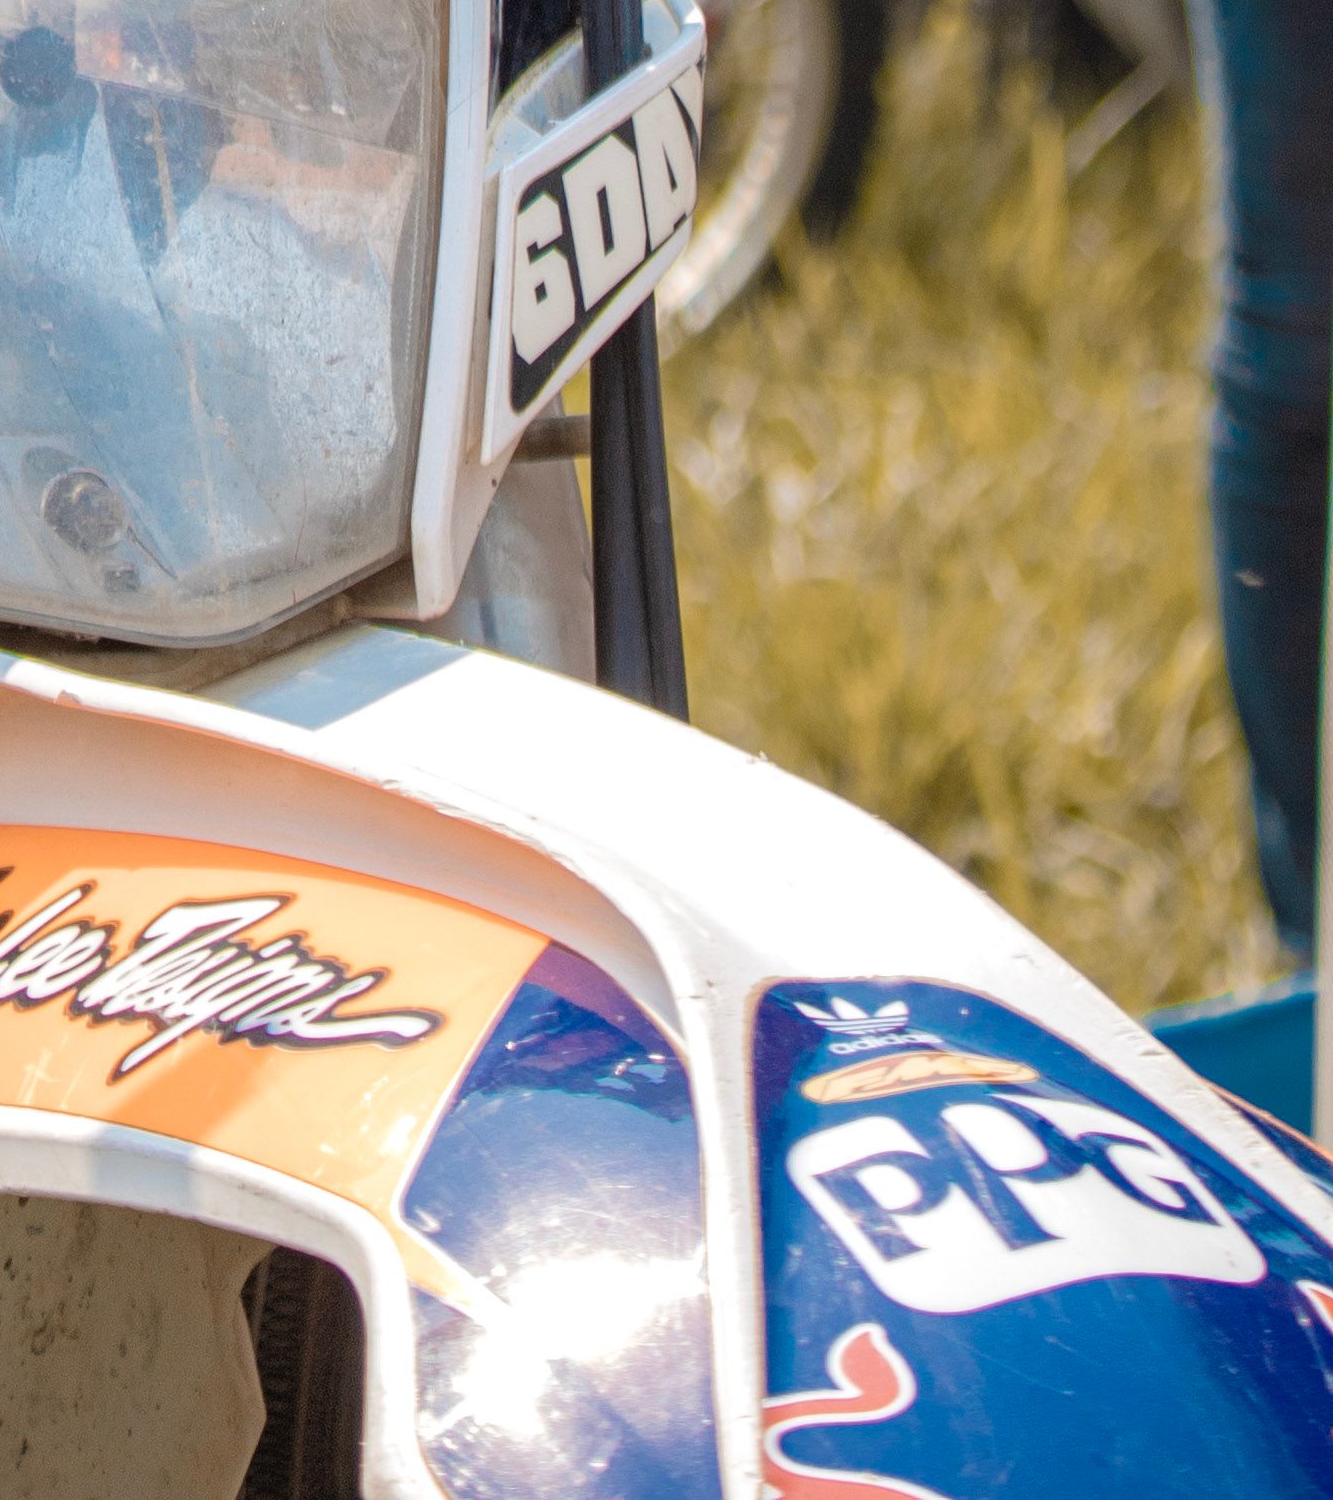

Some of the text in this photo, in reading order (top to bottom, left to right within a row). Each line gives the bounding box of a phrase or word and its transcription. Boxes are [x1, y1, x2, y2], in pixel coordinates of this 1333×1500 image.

[63, 894, 445, 1086] Designs
[828, 1033, 943, 1055] adidas
[813, 1092, 1223, 1263] PPG
